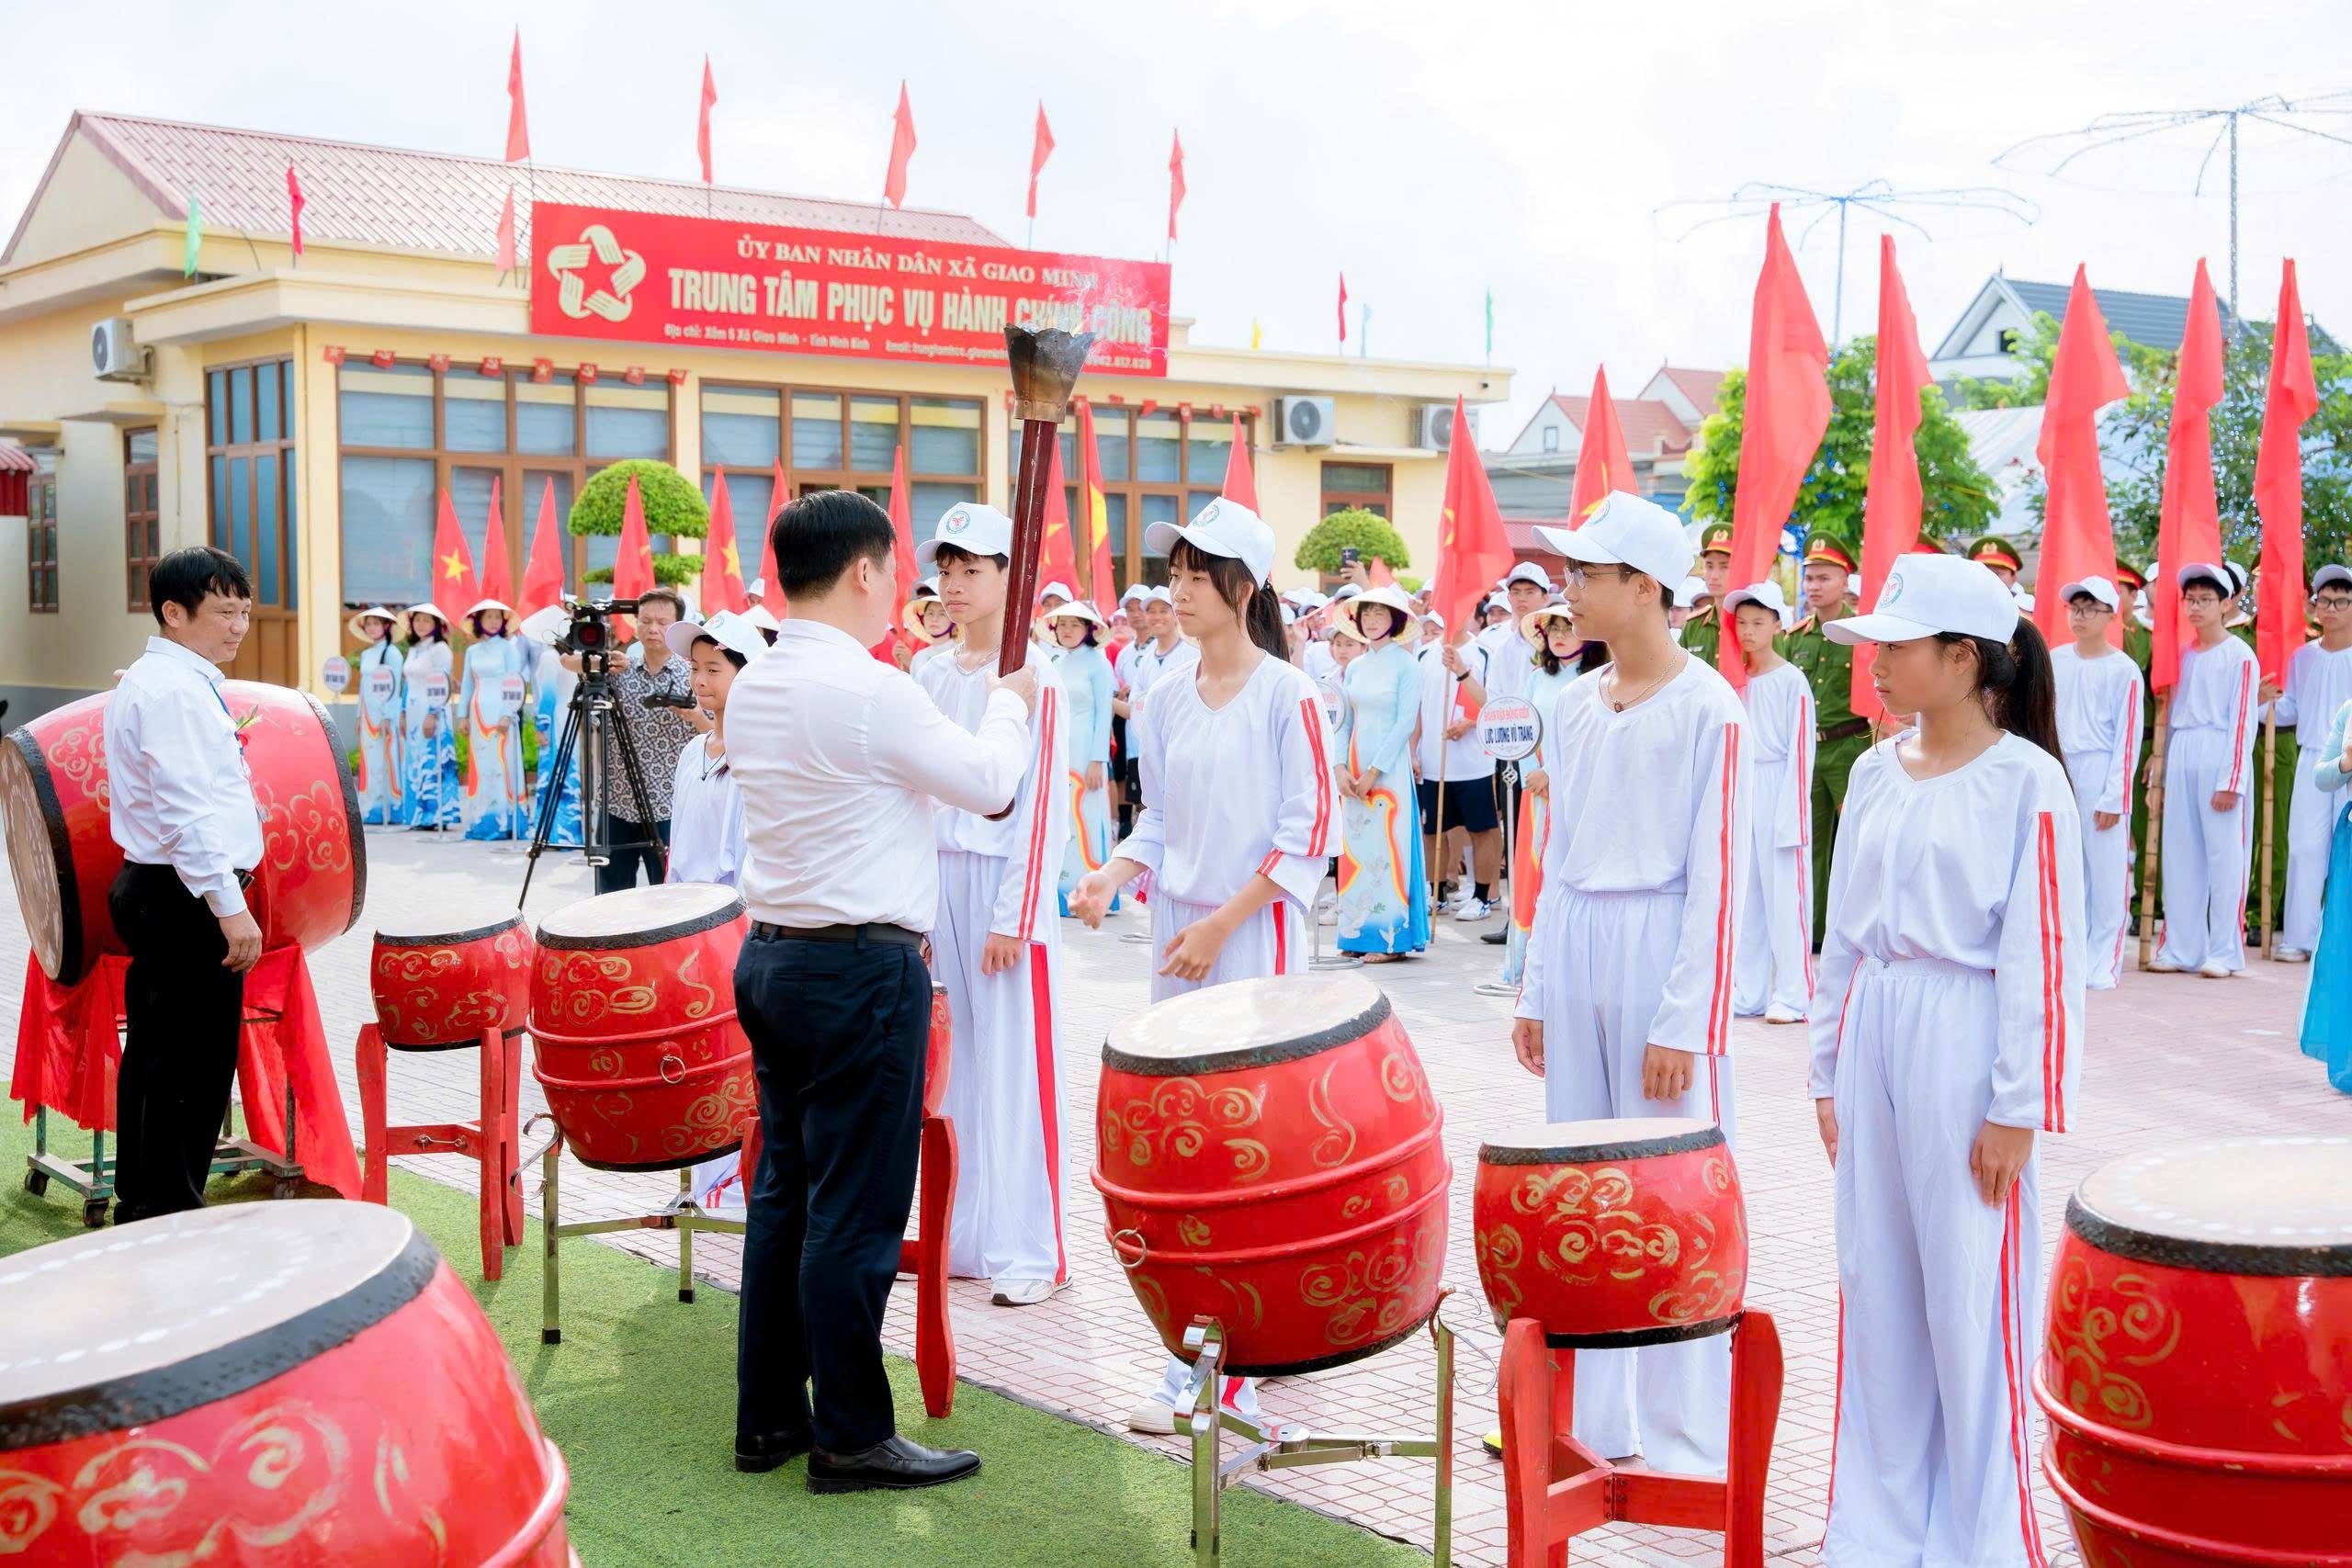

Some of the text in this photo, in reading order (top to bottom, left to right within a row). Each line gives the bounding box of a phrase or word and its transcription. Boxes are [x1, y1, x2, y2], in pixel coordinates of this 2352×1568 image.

[737, 233, 770, 258] ỦY
[775, 243, 820, 265] BAN
[828, 247, 892, 270] NHÂN
[898, 251, 942, 275] DÂN
[948, 256, 977, 279] XÃ
[982, 263, 1035, 283] GIAO
[668, 267, 757, 315] TRUNG
[763, 269, 819, 320] TÂM
[827, 282, 895, 332] PHỤC
[903, 288, 934, 336] VỤ
[942, 286, 1007, 333] HÀNH
[1091, 299, 1152, 344] CÔNG
